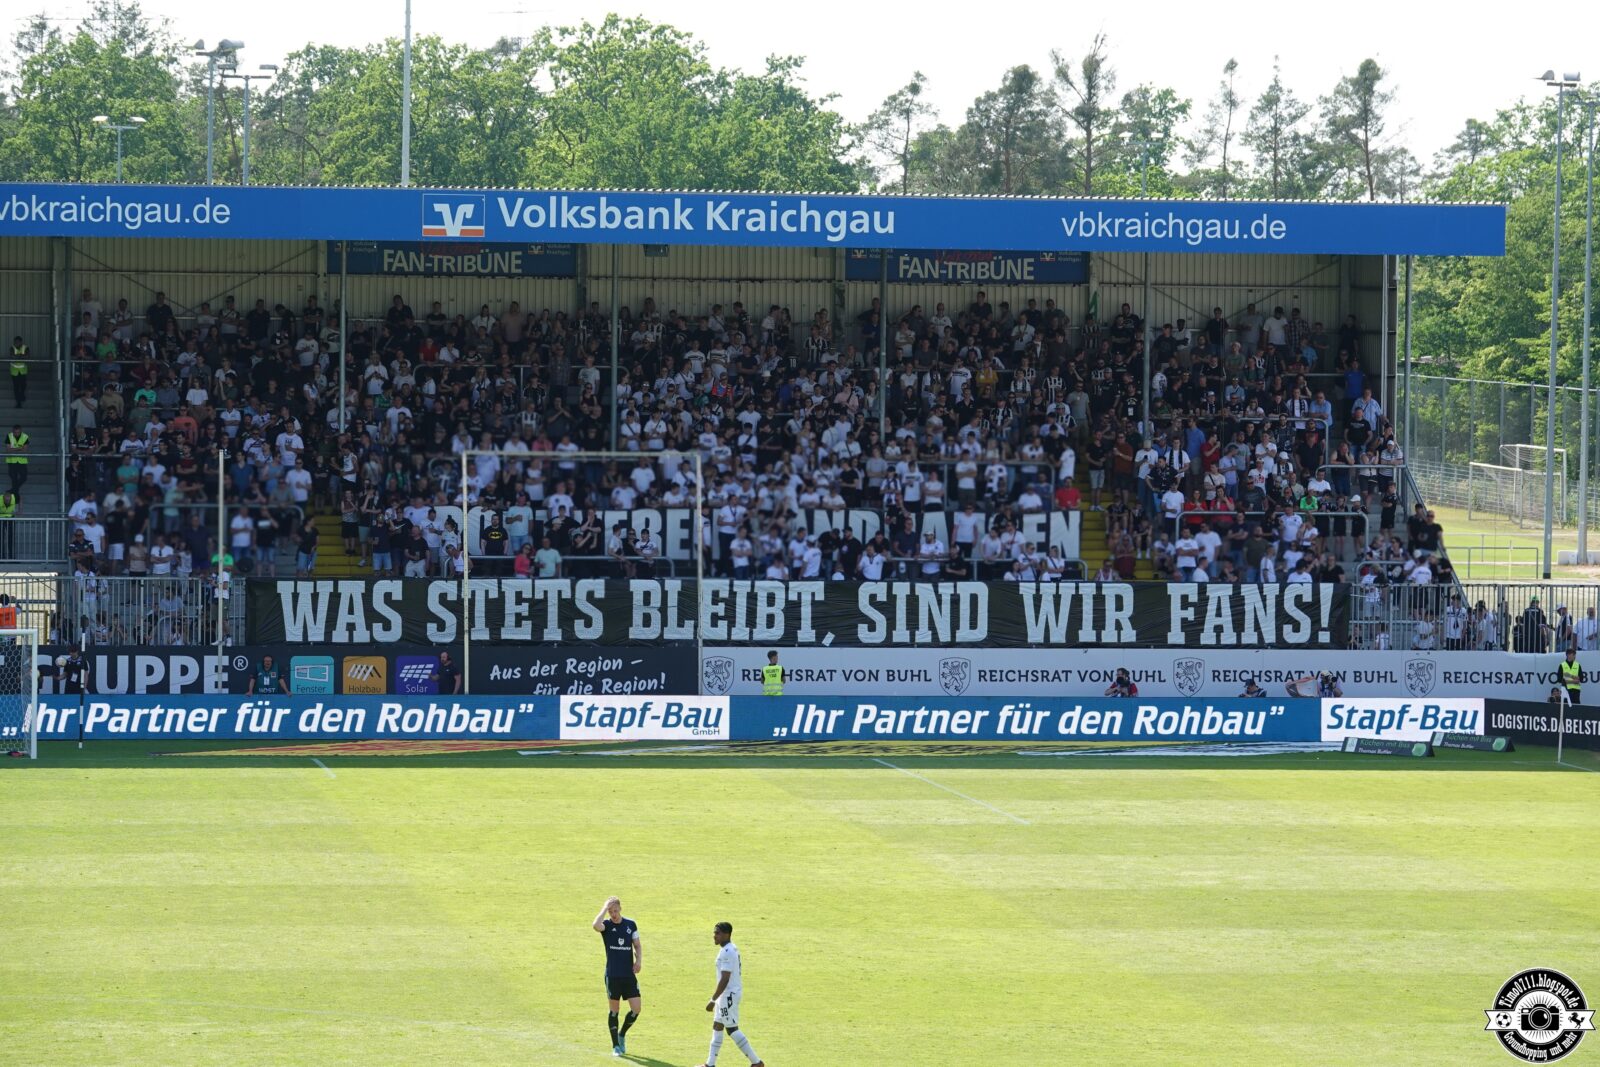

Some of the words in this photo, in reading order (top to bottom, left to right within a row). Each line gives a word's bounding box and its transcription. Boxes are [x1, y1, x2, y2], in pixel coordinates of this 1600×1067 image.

[0, 195, 230, 230] vbkraichgau.de
[498, 196, 695, 232] Volksbank
[706, 200, 896, 243] Kraichgau
[1062, 211, 1287, 246] vbkraichgau.de
[383, 248, 523, 275] FAN-TRIBÜNE
[899, 255, 1035, 281] FAN-TRIBÜNE
[276, 579, 404, 644] WAS
[426, 578, 606, 643] STETS
[628, 578, 836, 647] BLEIBT,
[857, 581, 990, 645] SIND
[1019, 582, 1137, 644] WIR
[1167, 583, 1335, 645] FANS!
[490, 664, 522, 681] Aus
[529, 660, 558, 678] der
[566, 656, 623, 678] Region
[741, 668, 837, 682] REHSRAT
[842, 669, 881, 682] VON
[886, 669, 932, 682] BUHL
[978, 669, 1072, 683] REICHSRAT
[1077, 670, 1114, 683] VON
[1353, 670, 1397, 683] BUHL
[1443, 671, 1534, 684] REICHSRAT
[296, 684, 327, 694] Fenster
[348, 684, 382, 694] Holzbau
[405, 684, 428, 693] Solar
[533, 682, 560, 695] für
[567, 680, 593, 695] die
[601, 671, 667, 695] Region!
[84, 702, 228, 733] Partner
[234, 701, 290, 733] für
[299, 703, 366, 733] den
[565, 702, 723, 733] Stapf-Bau
[851, 704, 988, 734] Partner
[996, 703, 1050, 735] für
[1058, 705, 1123, 735] den
[1326, 703, 1479, 735] Stapf-Bau
[692, 728, 721, 736] GmbH
[720, 1007, 729, 1017] 38
